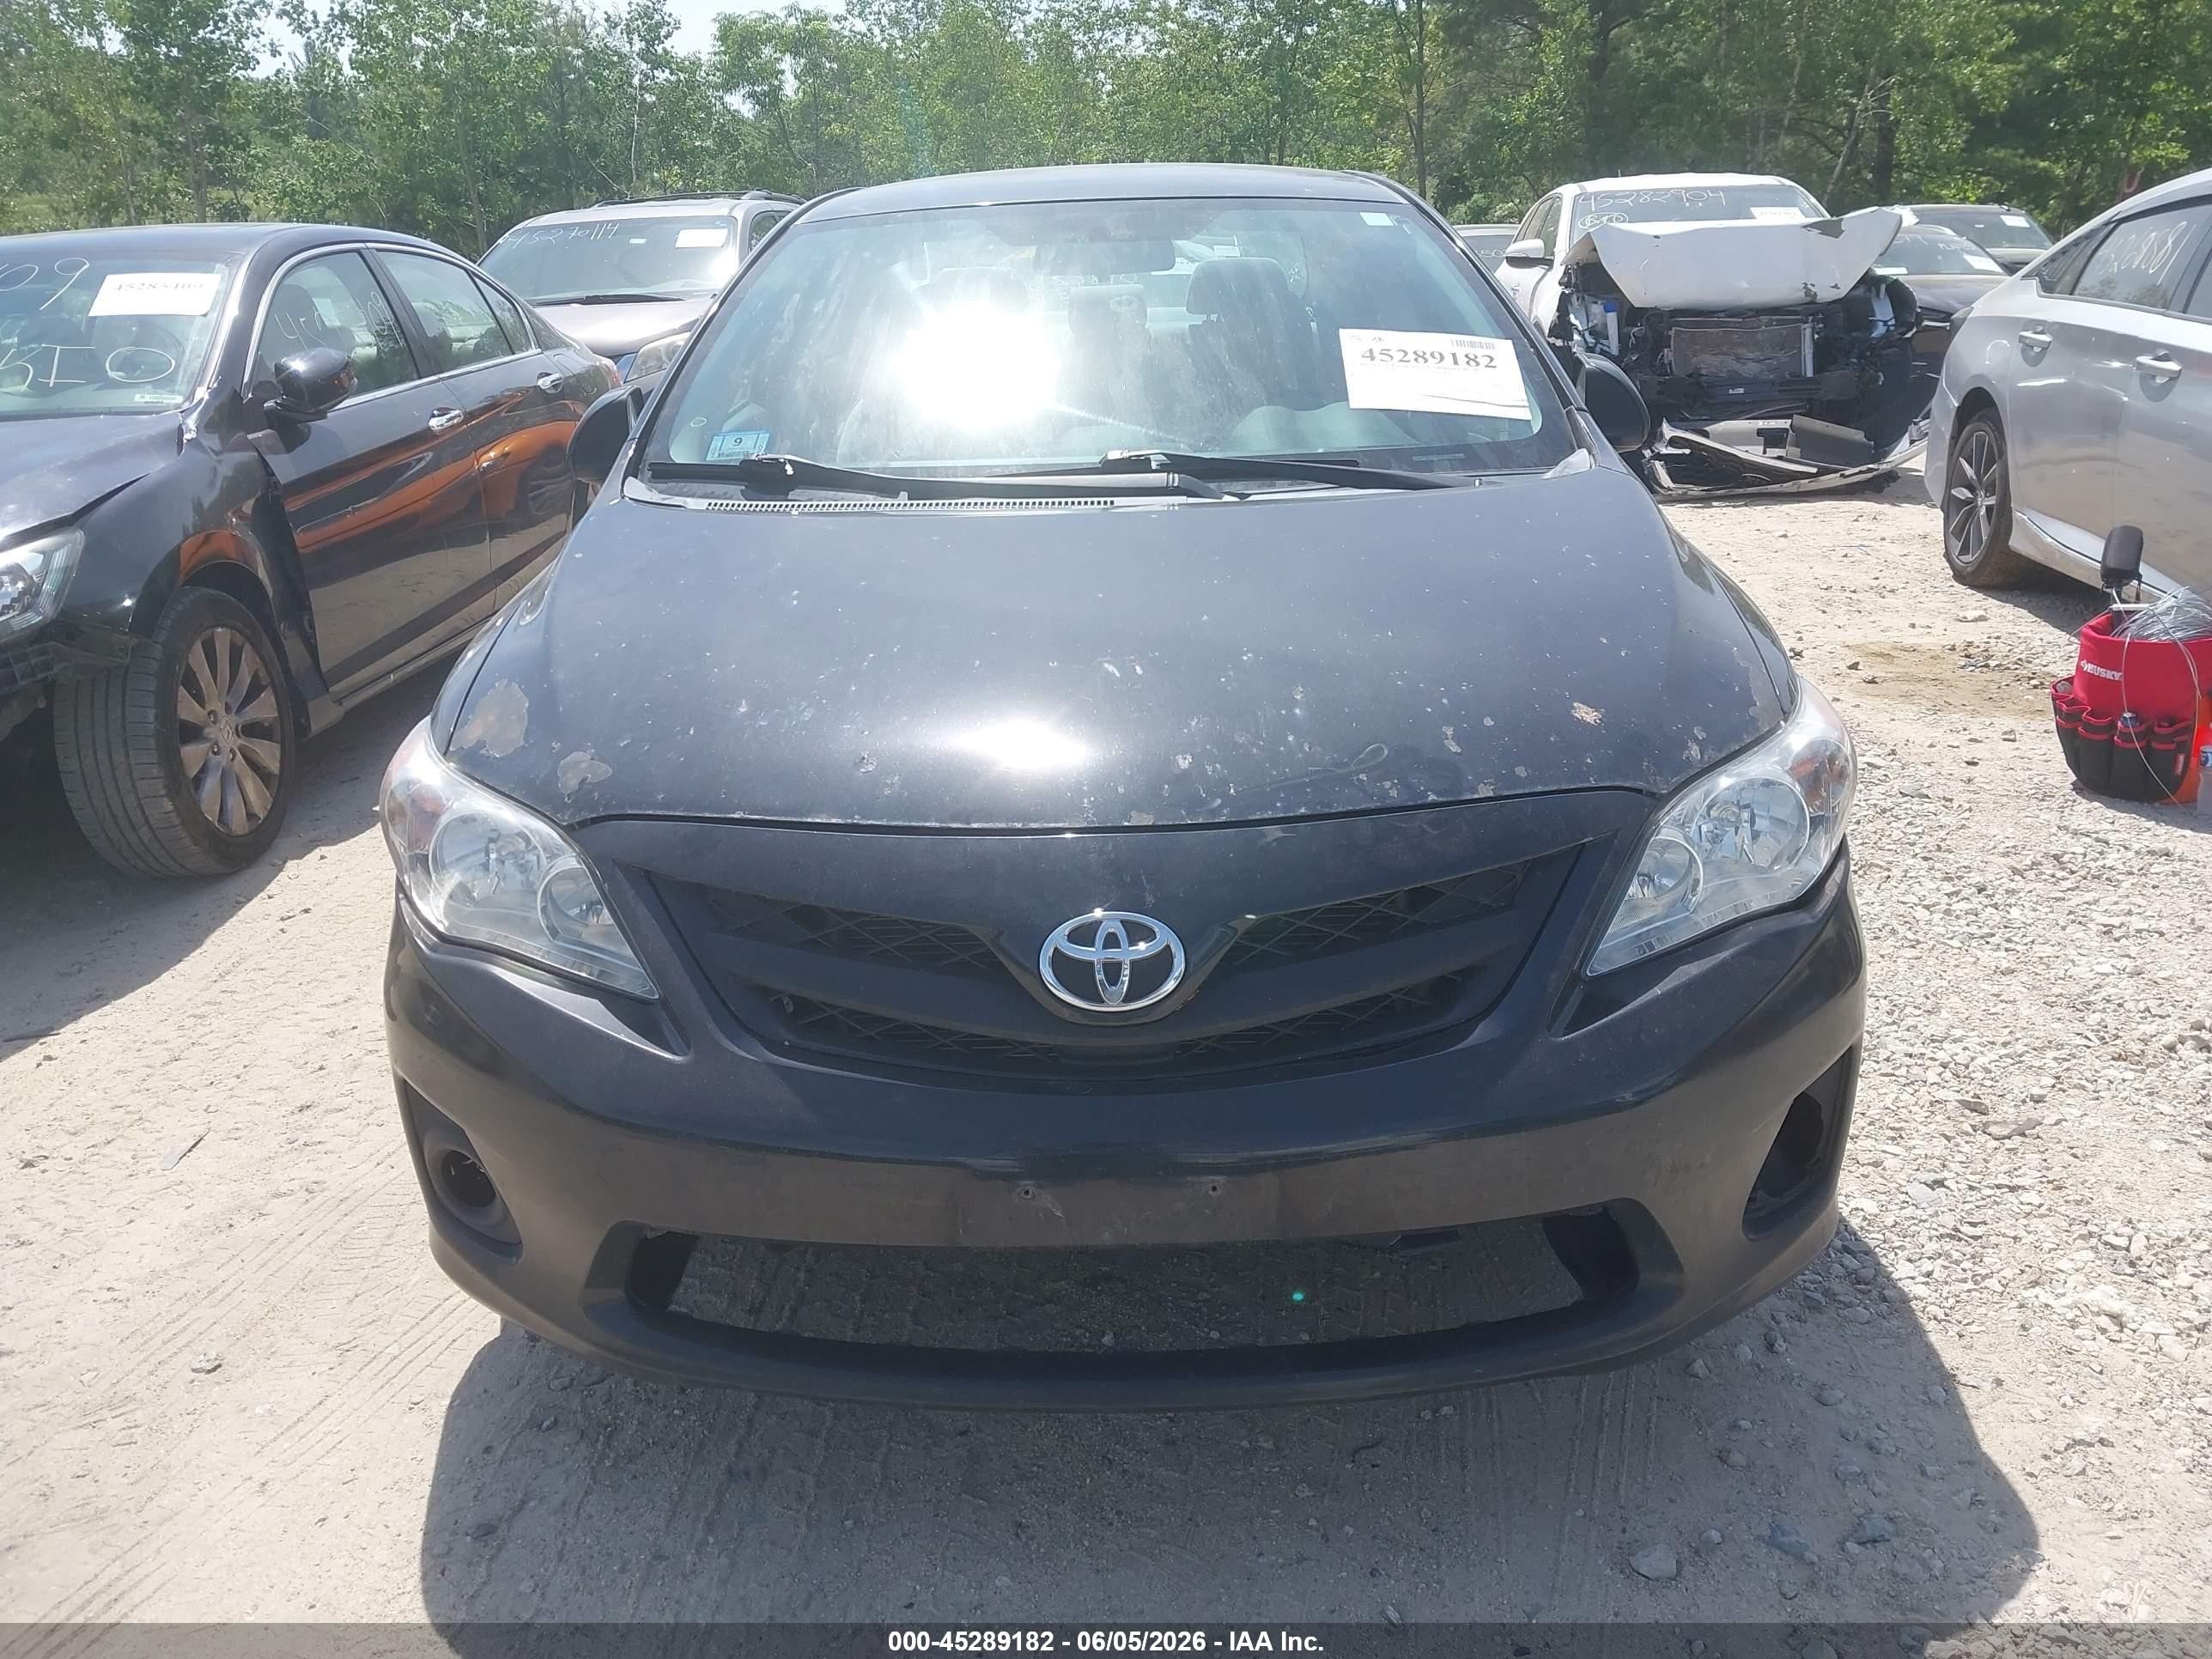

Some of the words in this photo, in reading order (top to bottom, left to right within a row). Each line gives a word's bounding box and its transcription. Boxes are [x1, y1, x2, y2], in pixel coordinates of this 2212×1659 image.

[1578, 189, 1726, 211] 45282904
[1361, 348, 1498, 369] 45289182
[733, 437, 743, 447] 9
[2087, 662, 2124, 681] HUSKY
